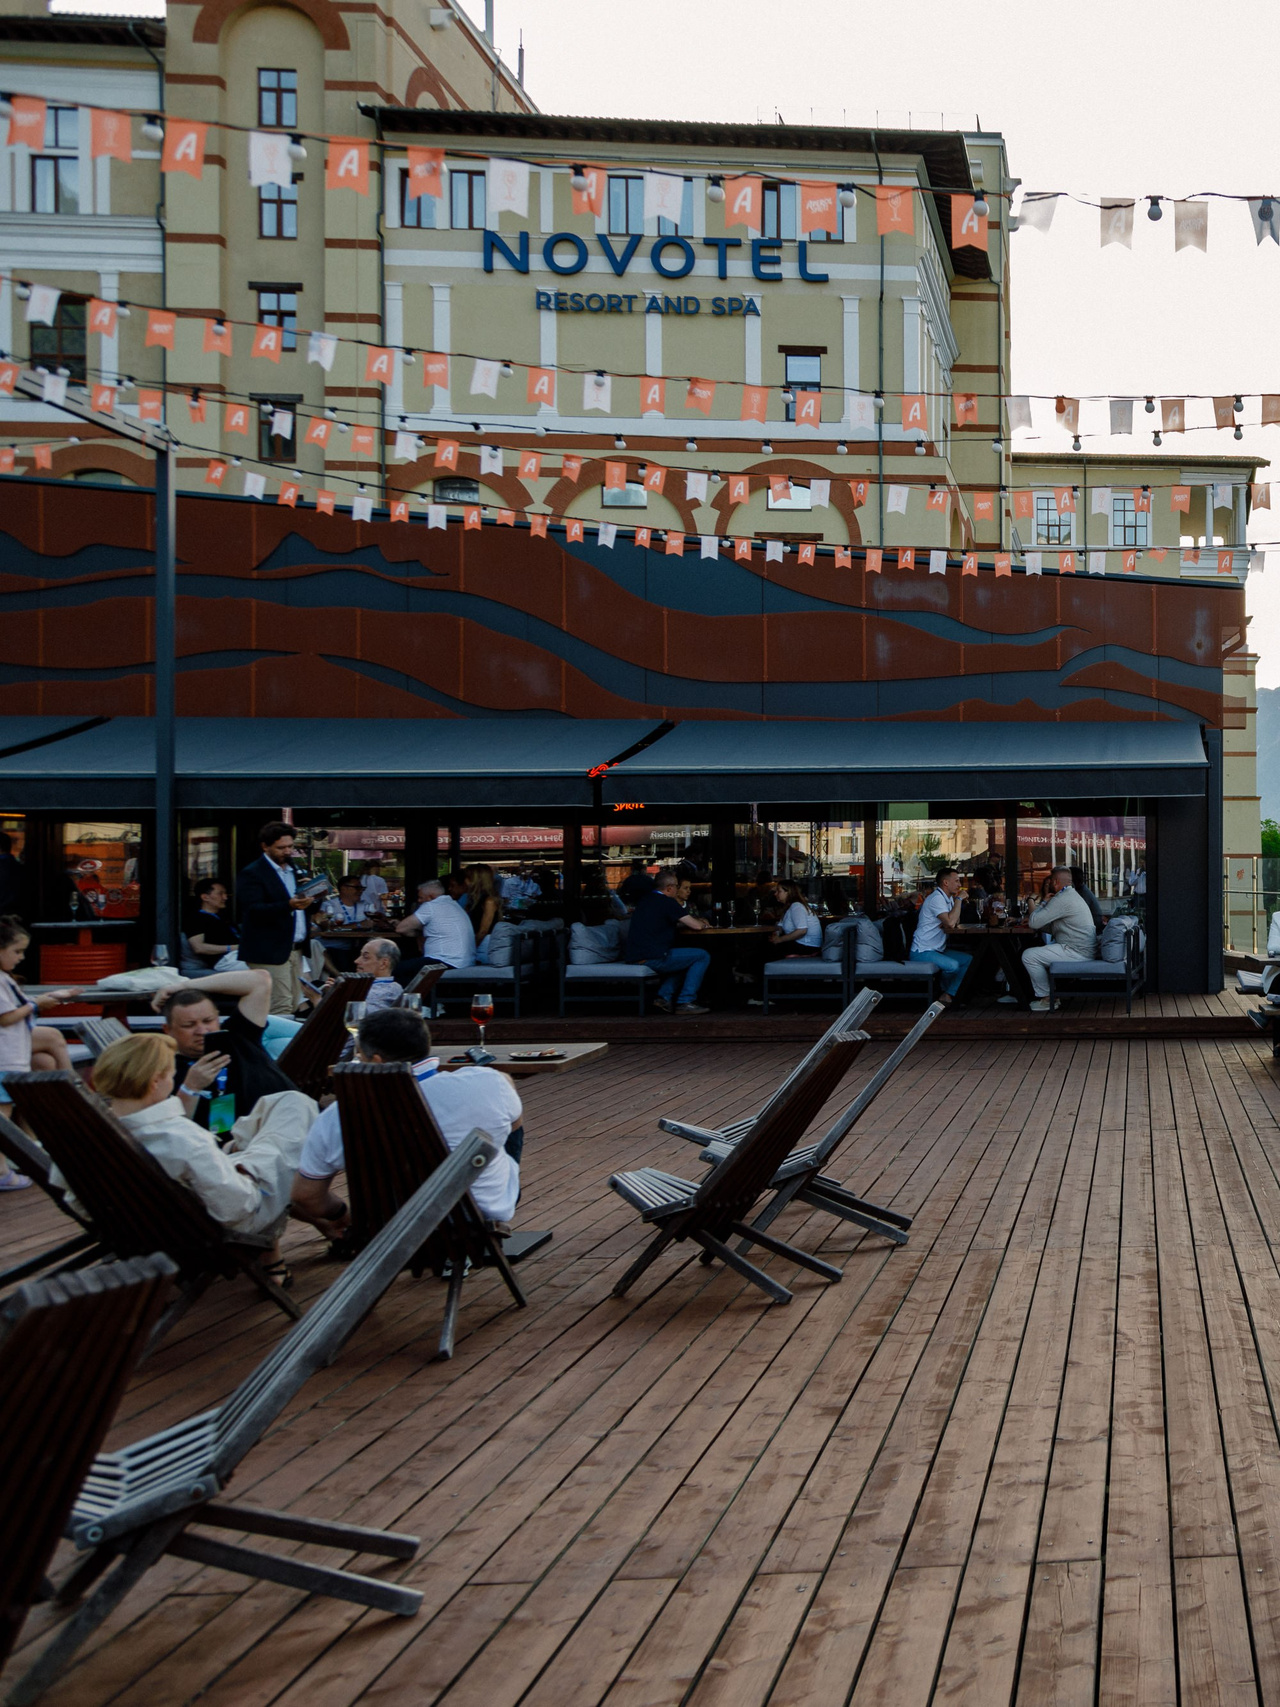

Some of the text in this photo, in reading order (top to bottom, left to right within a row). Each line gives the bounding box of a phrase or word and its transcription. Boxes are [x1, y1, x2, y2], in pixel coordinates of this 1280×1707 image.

[175, 133, 197, 162] A
[338, 149, 359, 177] A
[734, 187, 752, 213] A
[962, 210, 979, 234] A
[483, 229, 829, 283] NOVOTEL
[536, 291, 761, 317] RESORT AND SPA
[94, 308, 109, 325] A
[260, 331, 276, 350] A
[372, 355, 388, 373] A
[535, 376, 548, 394] A
[98, 391, 110, 405] A
[647, 384, 660, 404] A
[801, 399, 814, 417] A
[909, 403, 920, 421] A
[231, 411, 244, 425] A
[313, 425, 326, 438] A
[441, 447, 453, 460] A
[525, 458, 536, 472] A
[212, 467, 223, 479] A
[650, 471, 661, 485] A
[284, 488, 295, 500] A
[734, 481, 744, 496] A
[933, 492, 943, 504] A
[1061, 492, 1070, 508] A
[396, 503, 405, 515] A
[469, 511, 478, 524] A
[571, 524, 580, 536] A
[638, 529, 647, 540] A
[739, 542, 747, 554] A
[802, 547, 811, 558] A
[902, 551, 911, 562] A
[966, 557, 974, 569] A
[1063, 555, 1071, 567] A
[1127, 554, 1135, 567] A
[1222, 556, 1229, 568] A
